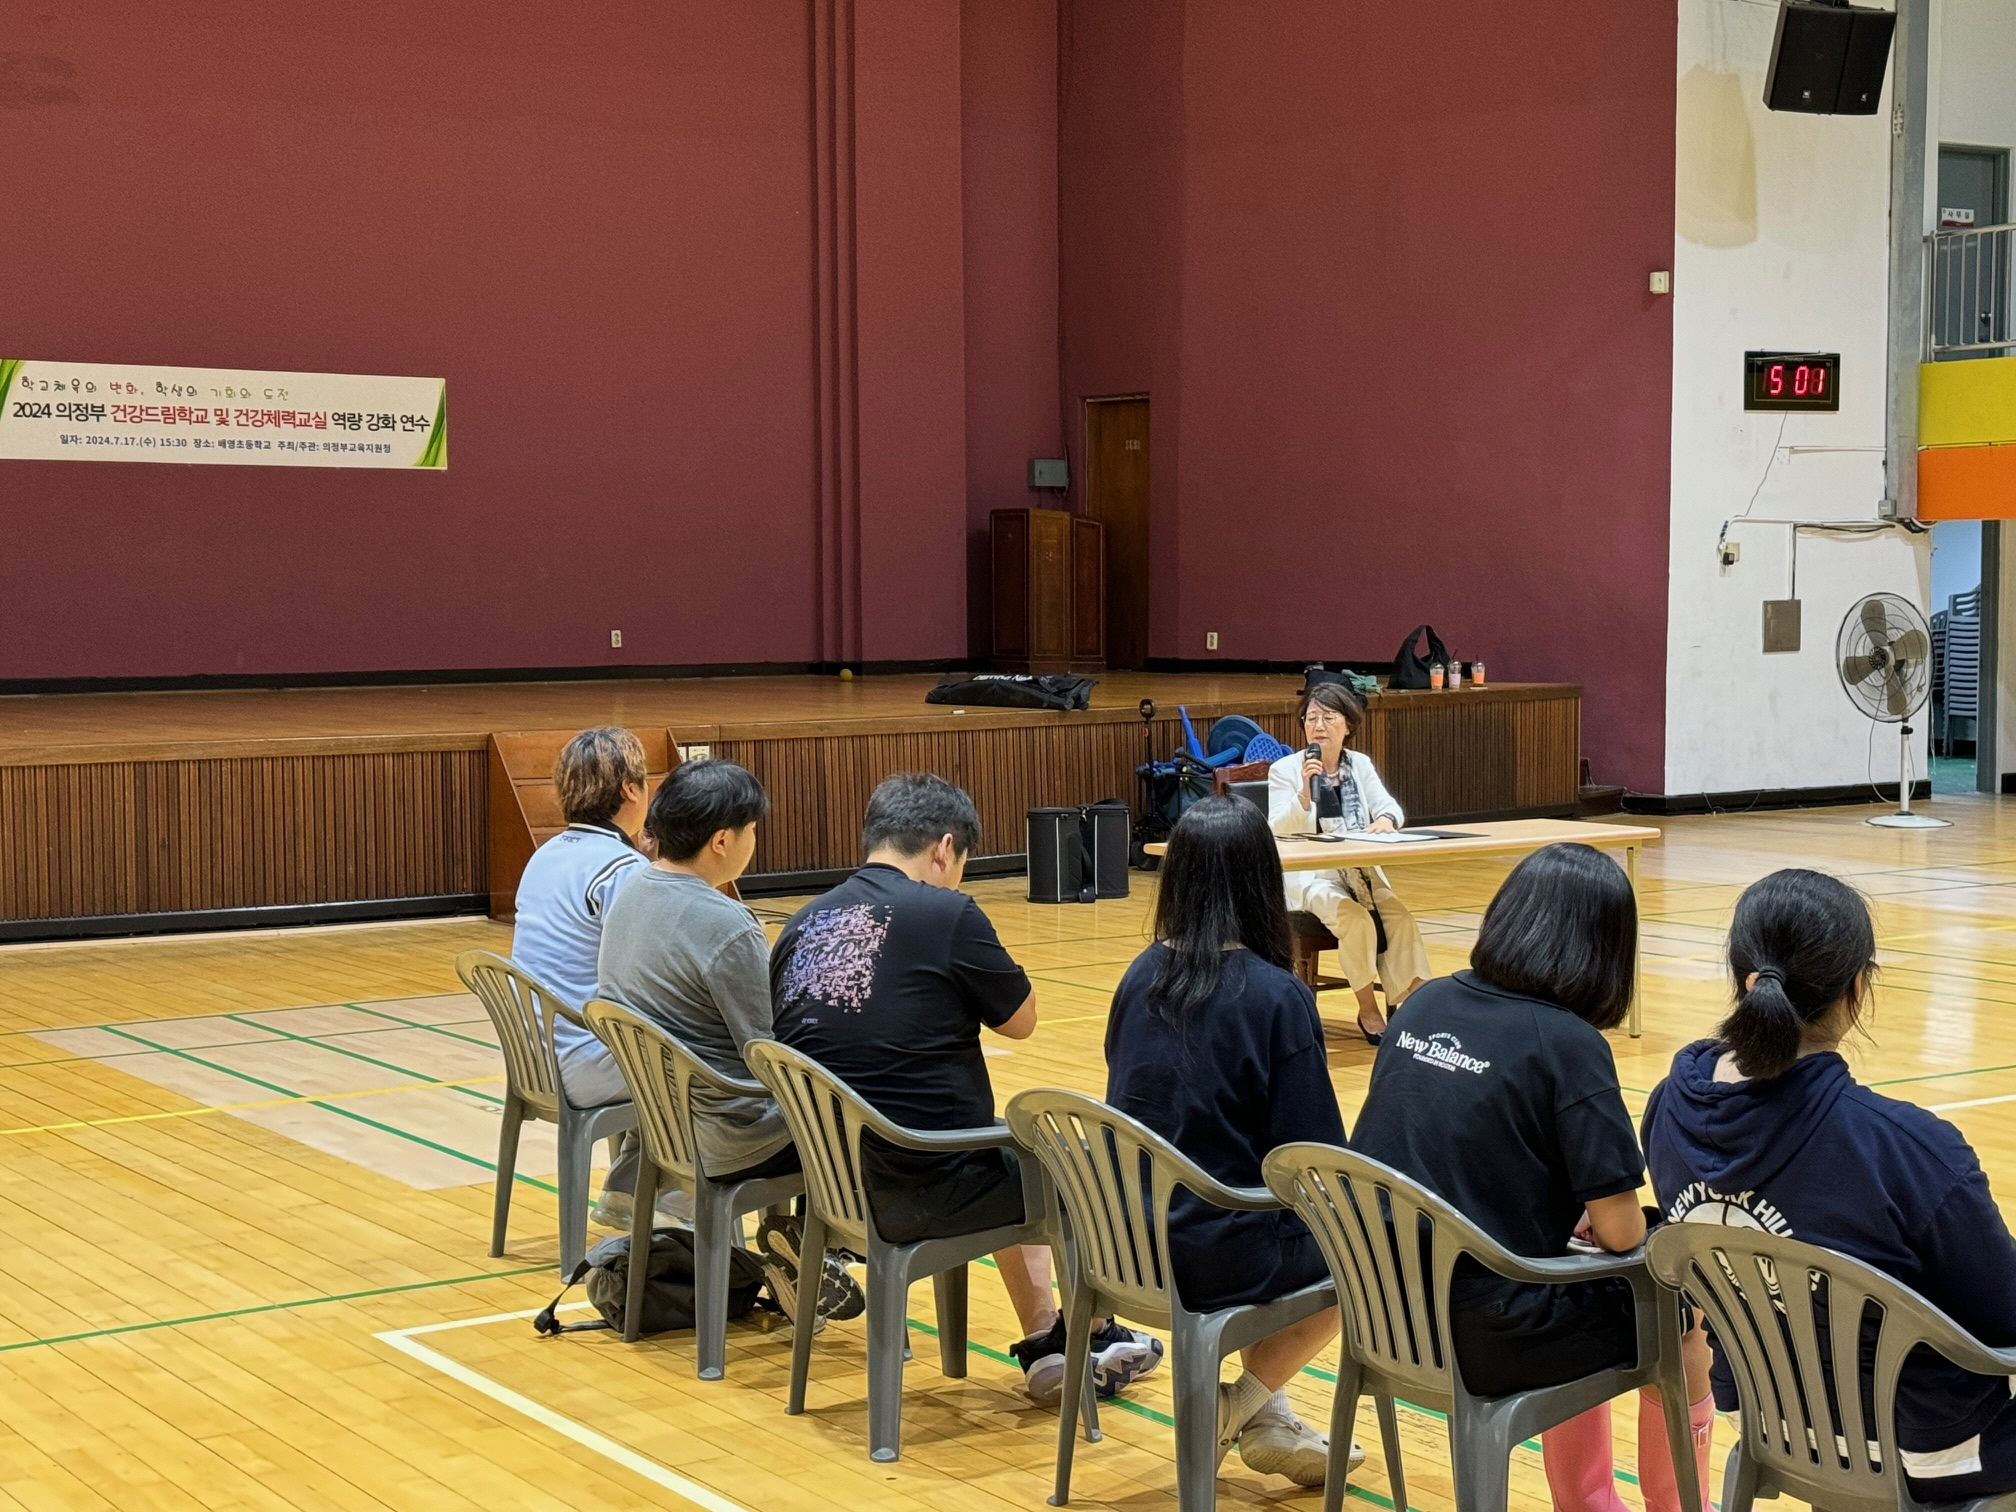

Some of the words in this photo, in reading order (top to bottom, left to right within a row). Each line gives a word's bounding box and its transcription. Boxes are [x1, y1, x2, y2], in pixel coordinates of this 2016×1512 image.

[21, 376, 97, 393] 학교체육의
[109, 382, 144, 395] 변화,
[156, 382, 198, 397] 학생의
[210, 386, 251, 398] 기회와
[263, 388, 288, 400] 도전
[13, 402, 52, 418] 2024
[55, 402, 107, 422] 의정부
[111, 404, 210, 425] 건강드림학교
[213, 408, 230, 426] 및
[234, 409, 327, 430] 건강체력교실
[331, 412, 363, 431] 역량
[365, 413, 397, 431] 강화
[400, 414, 431, 432] 연수
[60, 434, 82, 444] 일자:
[86, 436, 156, 447] 2024.7.17.(수)
[160, 438, 187, 447] 15:30
[193, 439, 215, 448] 장소:
[217, 439, 272, 450] 배영초등학교
[277, 441, 320, 452] 주최/주관:
[322, 442, 391, 453] 의정부교육지원청
[1396, 1031, 1430, 1053] New
